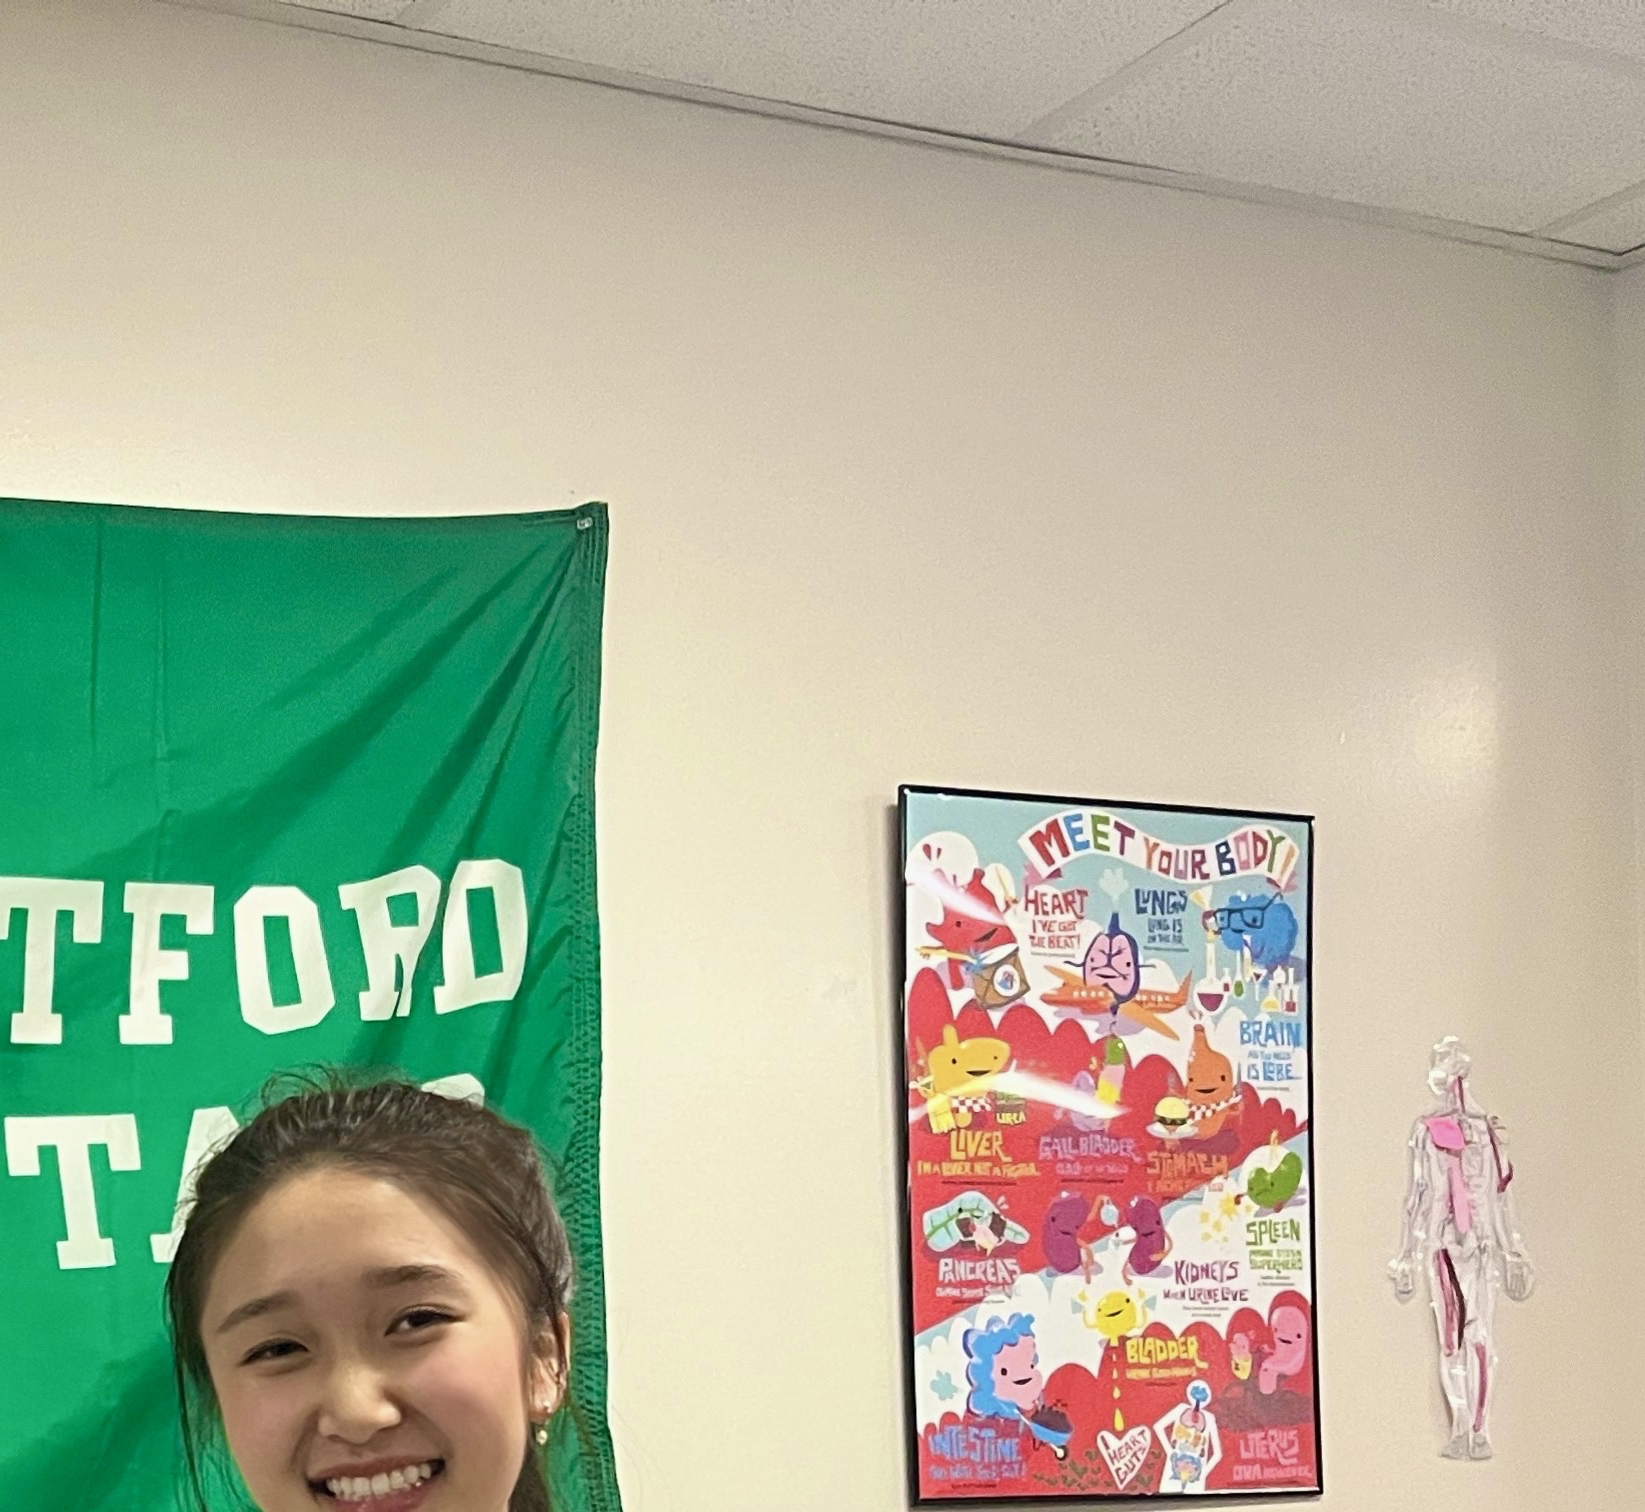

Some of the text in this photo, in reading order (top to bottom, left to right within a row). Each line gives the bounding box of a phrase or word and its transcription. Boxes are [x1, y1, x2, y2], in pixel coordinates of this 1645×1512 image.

[1029, 813, 1297, 880] MEET YOUR BODY!
[1024, 884, 1089, 920] HEART
[1135, 888, 1188, 915] LUNGS
[1240, 1020, 1301, 1048] BRAIN
[950, 1128, 1013, 1163] LIVER
[1246, 1218, 1301, 1245] SPLEEN
[938, 1257, 1021, 1284] PANCREAS
[1174, 1260, 1240, 1286] KIDNEYS
[1188, 1288, 1220, 1304] URINE
[1221, 1286, 1249, 1302] LOVE
[1126, 1336, 1208, 1369] BLADDER
[1109, 1430, 1149, 1465] HEART
[1115, 1447, 1146, 1482] GUTS
